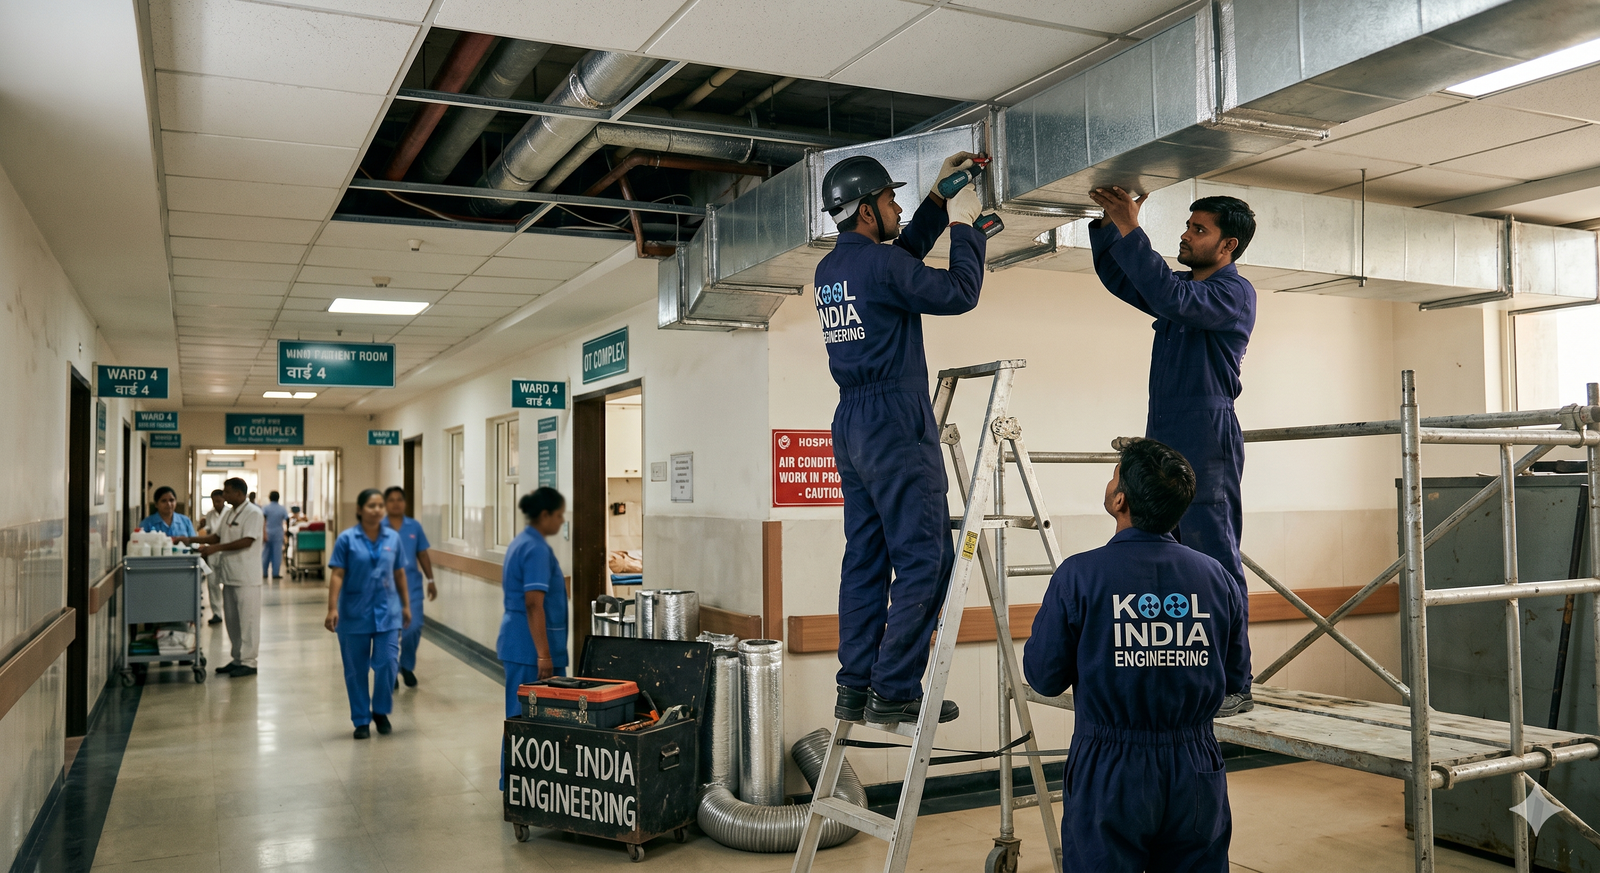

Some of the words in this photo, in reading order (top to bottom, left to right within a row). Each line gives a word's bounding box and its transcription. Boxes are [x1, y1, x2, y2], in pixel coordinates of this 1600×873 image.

[815, 280, 856, 306] KOOL
[817, 303, 862, 329] NDIA
[359, 351, 388, 362] ROOM
[584, 352, 593, 372] OT
[593, 341, 625, 369] COMPLEX
[107, 368, 146, 381] WARD
[150, 370, 158, 381] 4
[317, 367, 326, 379] 4
[141, 385, 149, 395] 4
[520, 382, 550, 394] WARD
[552, 384, 558, 394] 4
[546, 397, 552, 407] 4
[141, 412, 165, 421] WARD
[167, 412, 172, 421] 4
[233, 426, 247, 436] OT
[249, 426, 297, 436] COMPLEX
[779, 456, 795, 468] AIR
[797, 456, 837, 468] CONDITI
[779, 472, 808, 483] WORK
[810, 472, 819, 483] IN
[1112, 592, 1211, 619] KOOL
[1114, 621, 1210, 647] INDIA
[1114, 650, 1209, 667] ENGINEERING
[511, 734, 568, 774] KOOL
[575, 744, 636, 786] INDIA
[509, 774, 636, 831] ENGINEERING
